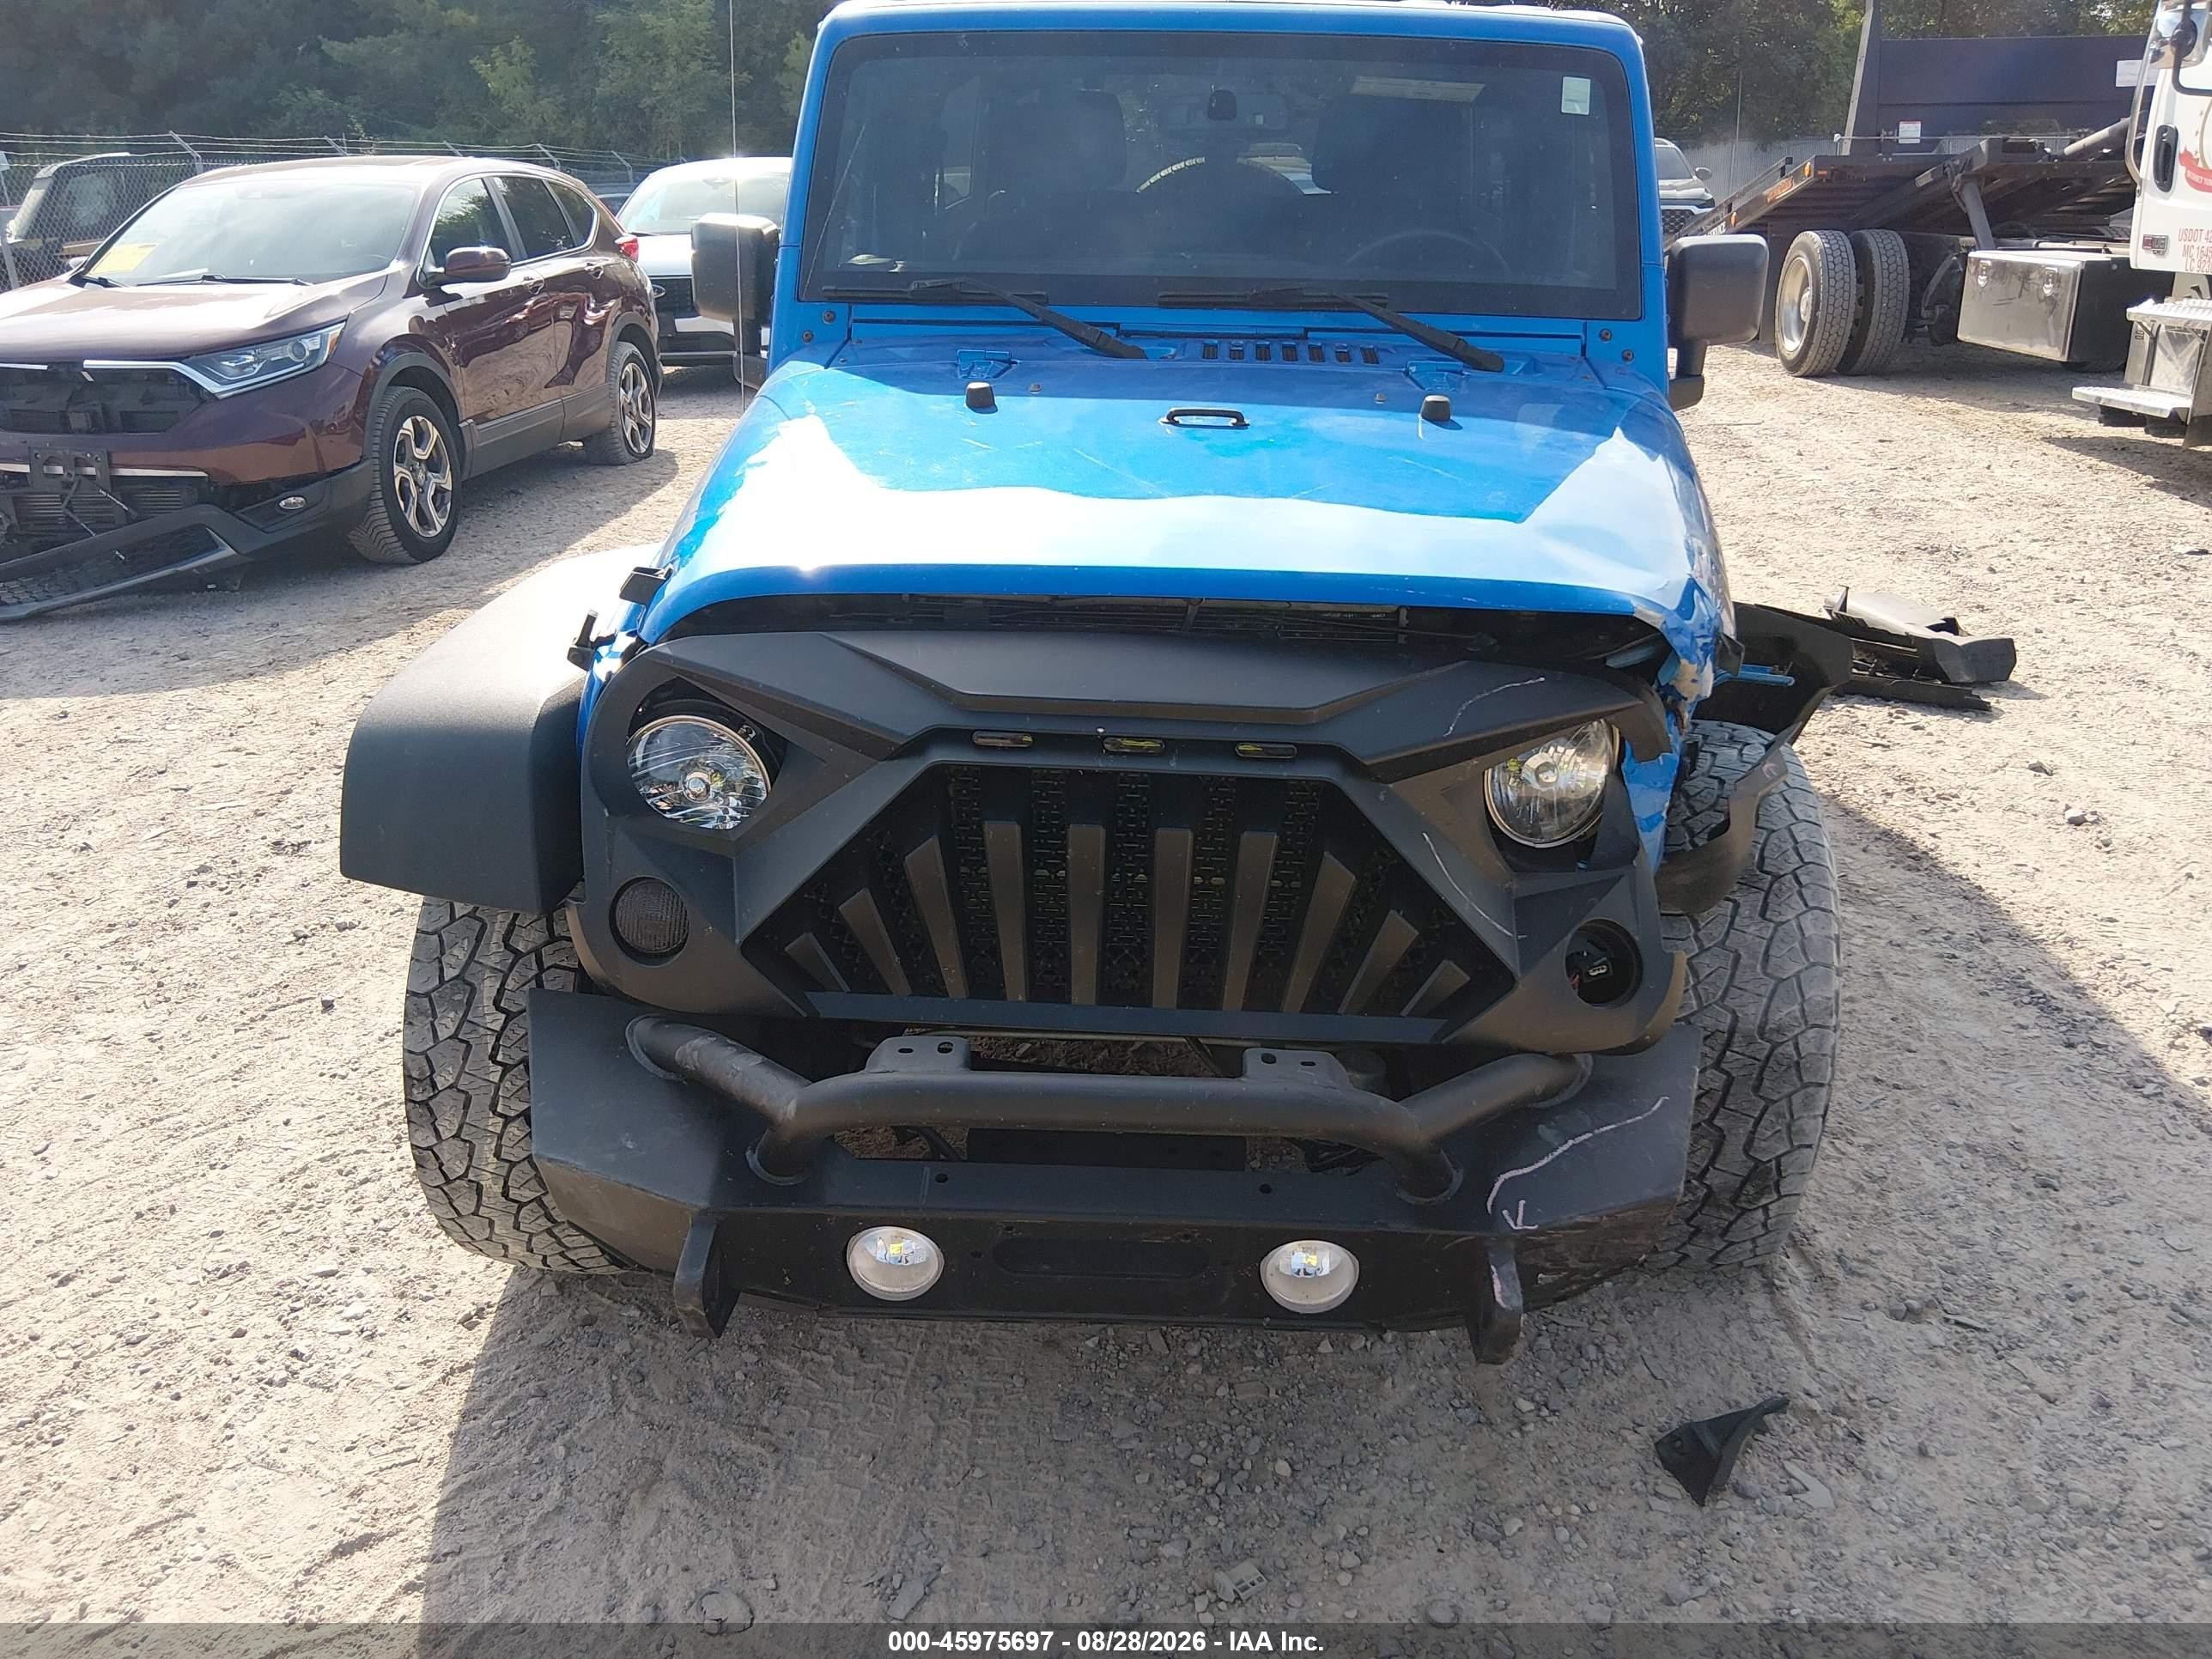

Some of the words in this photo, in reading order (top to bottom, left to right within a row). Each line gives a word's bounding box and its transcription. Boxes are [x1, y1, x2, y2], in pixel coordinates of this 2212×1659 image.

[2178, 228, 2204, 242] USDOT
[2182, 244, 2194, 258] MC
[2185, 258, 2195, 271] LC
